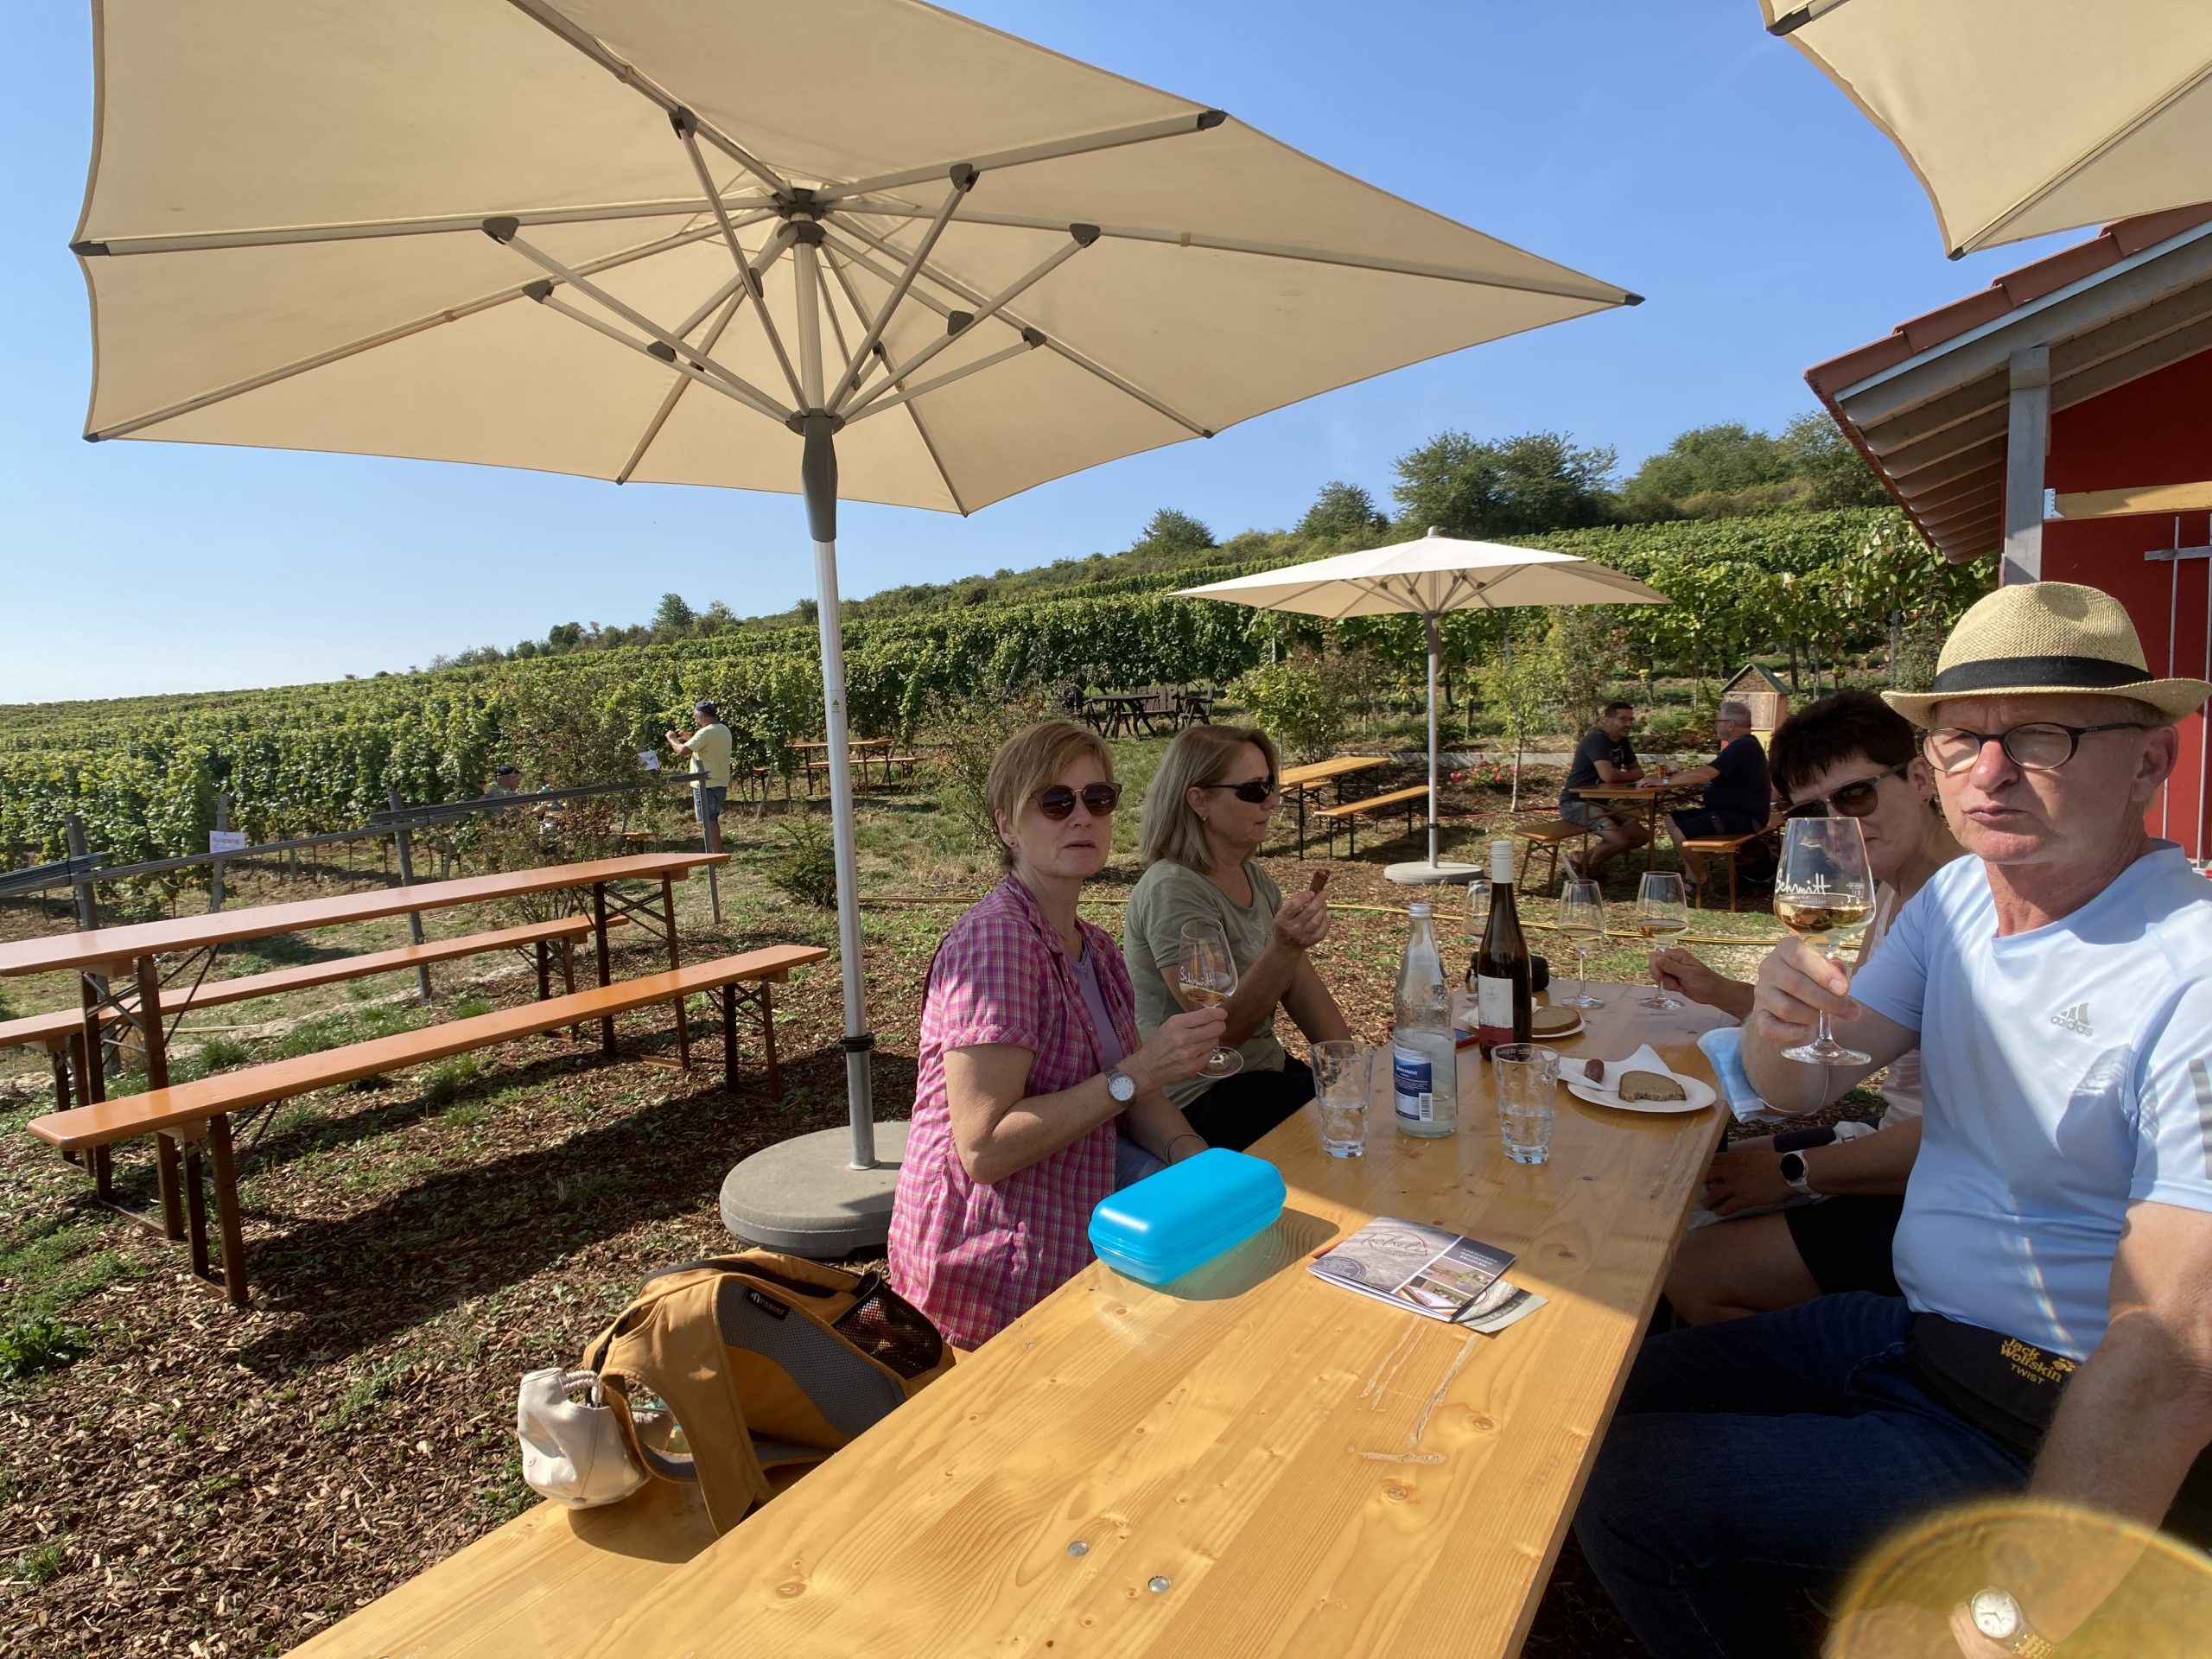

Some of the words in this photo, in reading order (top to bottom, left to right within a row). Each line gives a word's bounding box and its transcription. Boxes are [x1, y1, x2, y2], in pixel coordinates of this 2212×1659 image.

[1774, 868, 1832, 896] Schmitt
[1179, 965, 1217, 988] Schmitt
[2050, 1014, 2094, 1038] adidas
[2003, 1337, 2042, 1360] Jack
[1999, 1344, 2063, 1383] Wolfskin
[2010, 1363, 2046, 1386] TWIST
